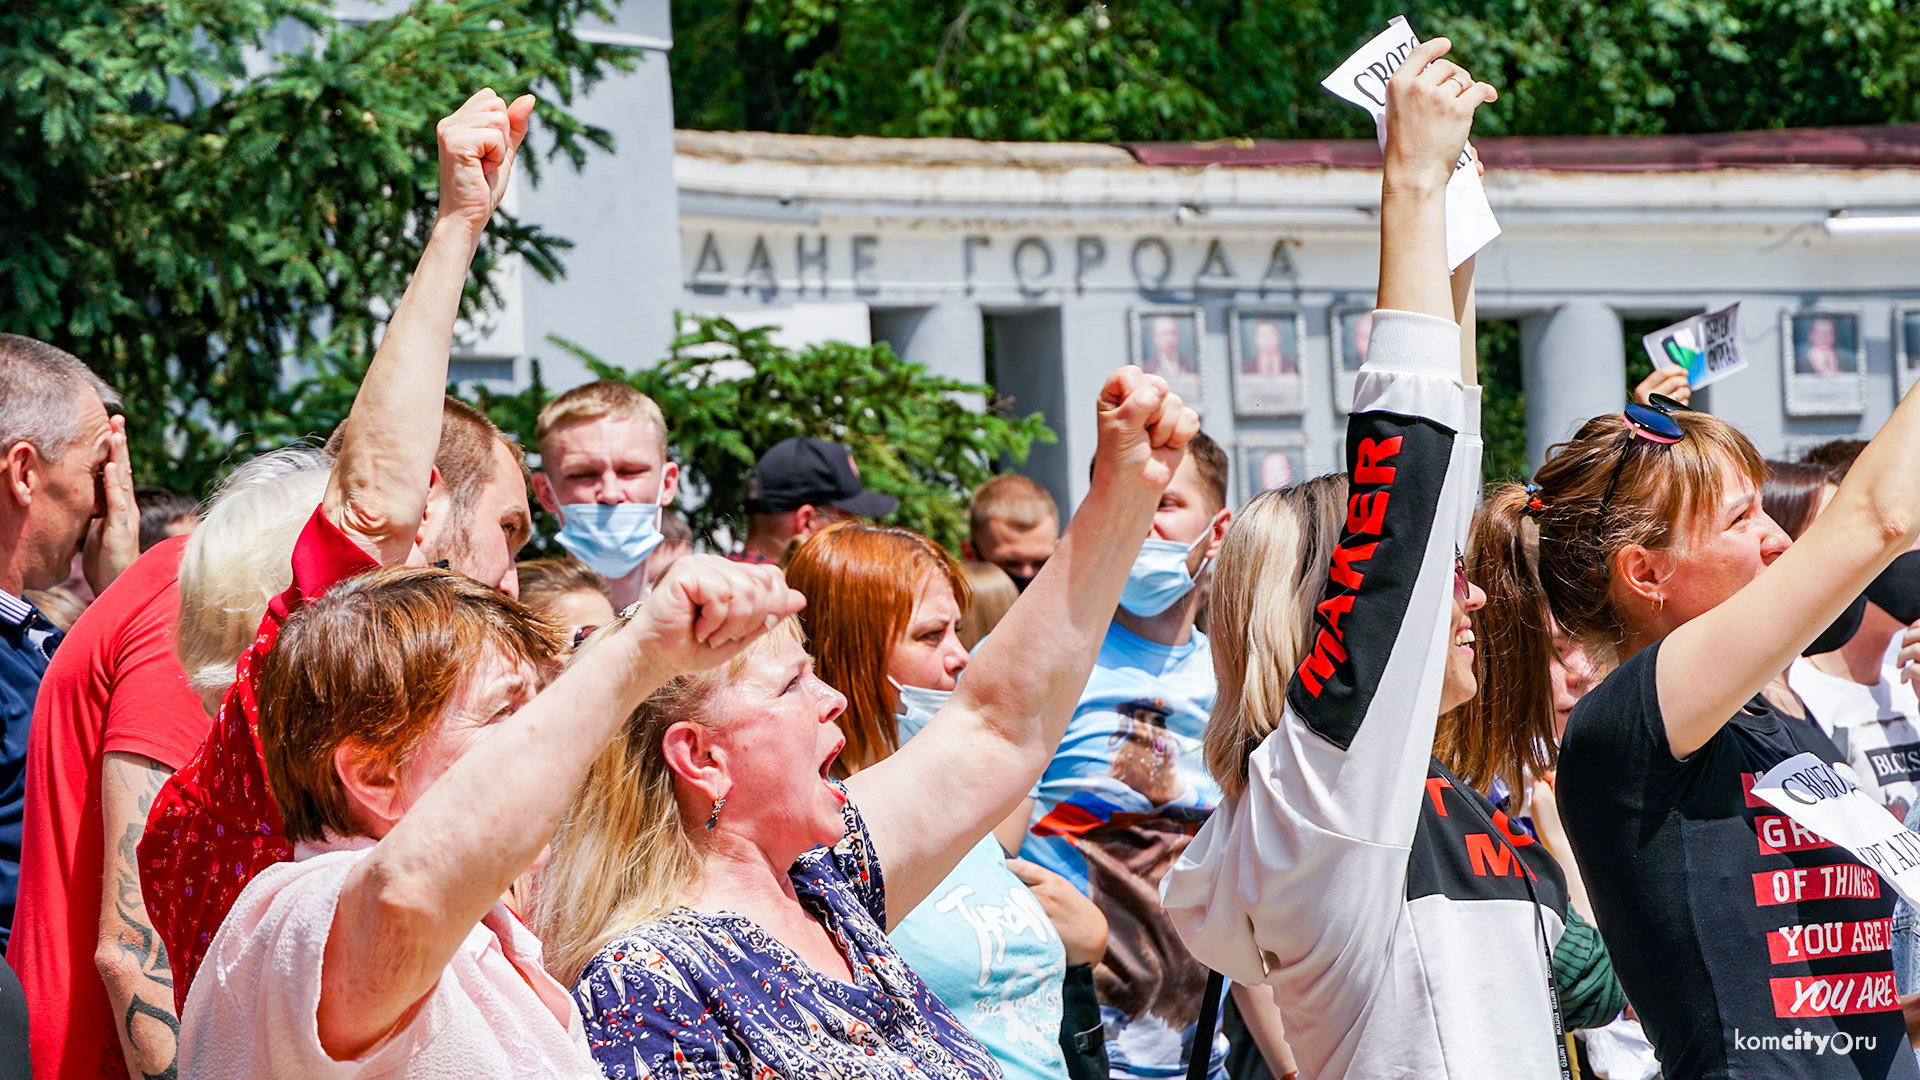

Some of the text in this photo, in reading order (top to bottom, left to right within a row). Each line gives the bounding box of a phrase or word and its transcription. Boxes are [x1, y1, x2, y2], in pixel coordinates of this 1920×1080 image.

[962, 236, 1303, 299] ГОРОДА
[1298, 435, 1404, 698] MAKER
[1781, 763, 1860, 805] СВОБО
[1772, 866, 1875, 903] OF THINGS
[1778, 921, 1843, 957] YOU
[1850, 918, 1883, 953] ARE
[1789, 978, 1856, 1015] YOU
[1855, 974, 1892, 1010] ARE
[1553, 1012, 1562, 1036] EDITION
